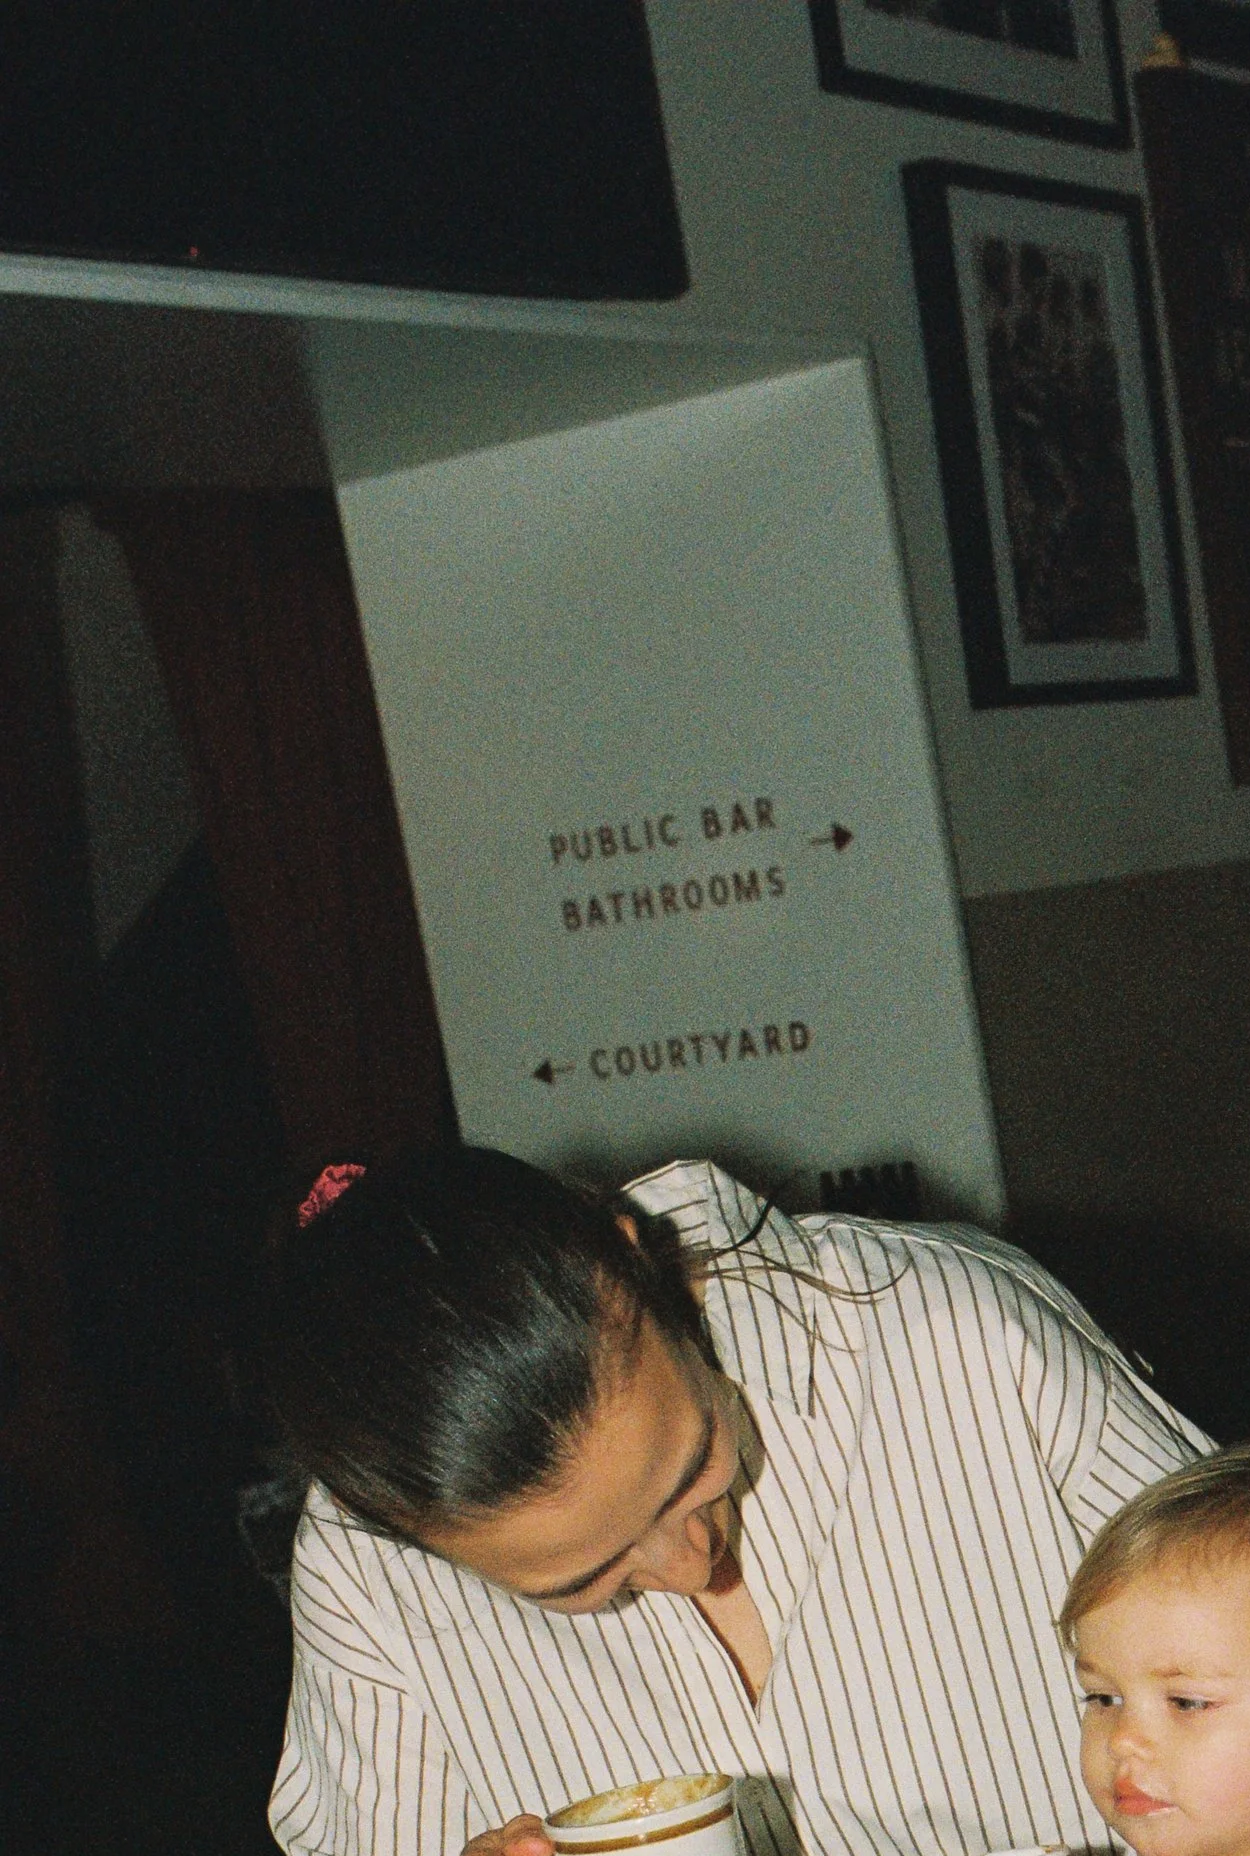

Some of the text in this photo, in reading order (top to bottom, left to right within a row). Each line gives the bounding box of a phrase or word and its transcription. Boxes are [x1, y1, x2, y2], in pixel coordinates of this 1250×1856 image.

[549, 797, 777, 865] PUBLIC BAR
[561, 865, 787, 932] BATHROOMS
[589, 1020, 813, 1080] COURTYARD
